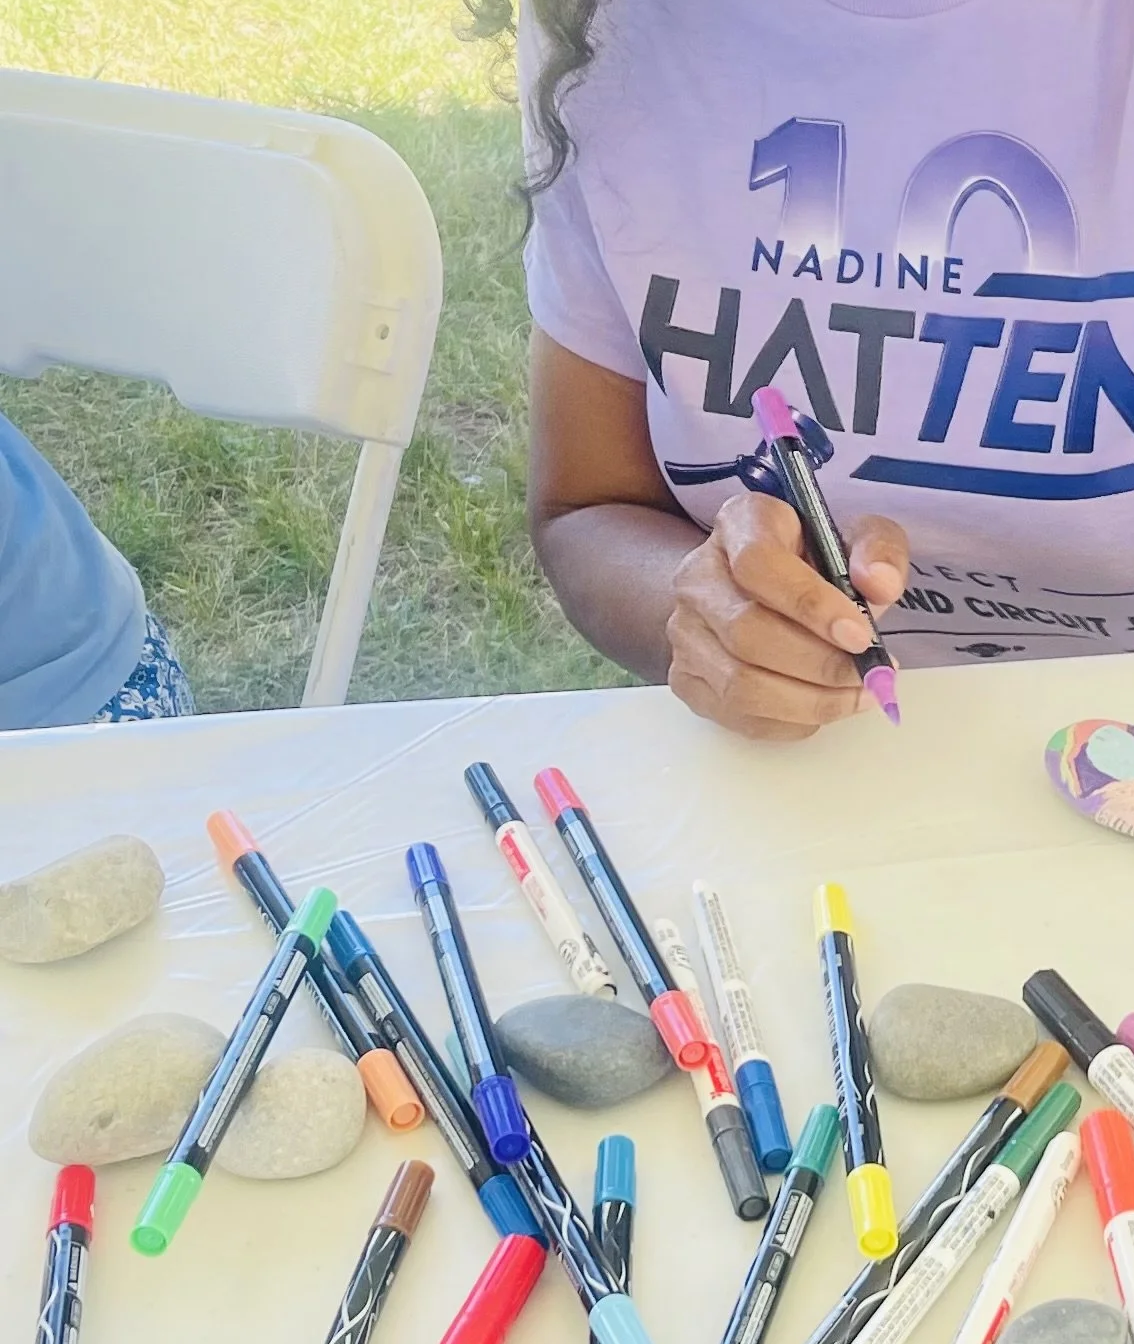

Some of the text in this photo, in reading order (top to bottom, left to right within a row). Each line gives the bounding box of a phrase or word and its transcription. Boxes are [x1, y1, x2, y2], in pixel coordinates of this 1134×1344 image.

[748, 116, 1080, 273] 10
[751, 236, 965, 295] NADINE
[909, 560, 1020, 593] LECT
[963, 596, 1112, 639] CIRCUIT
